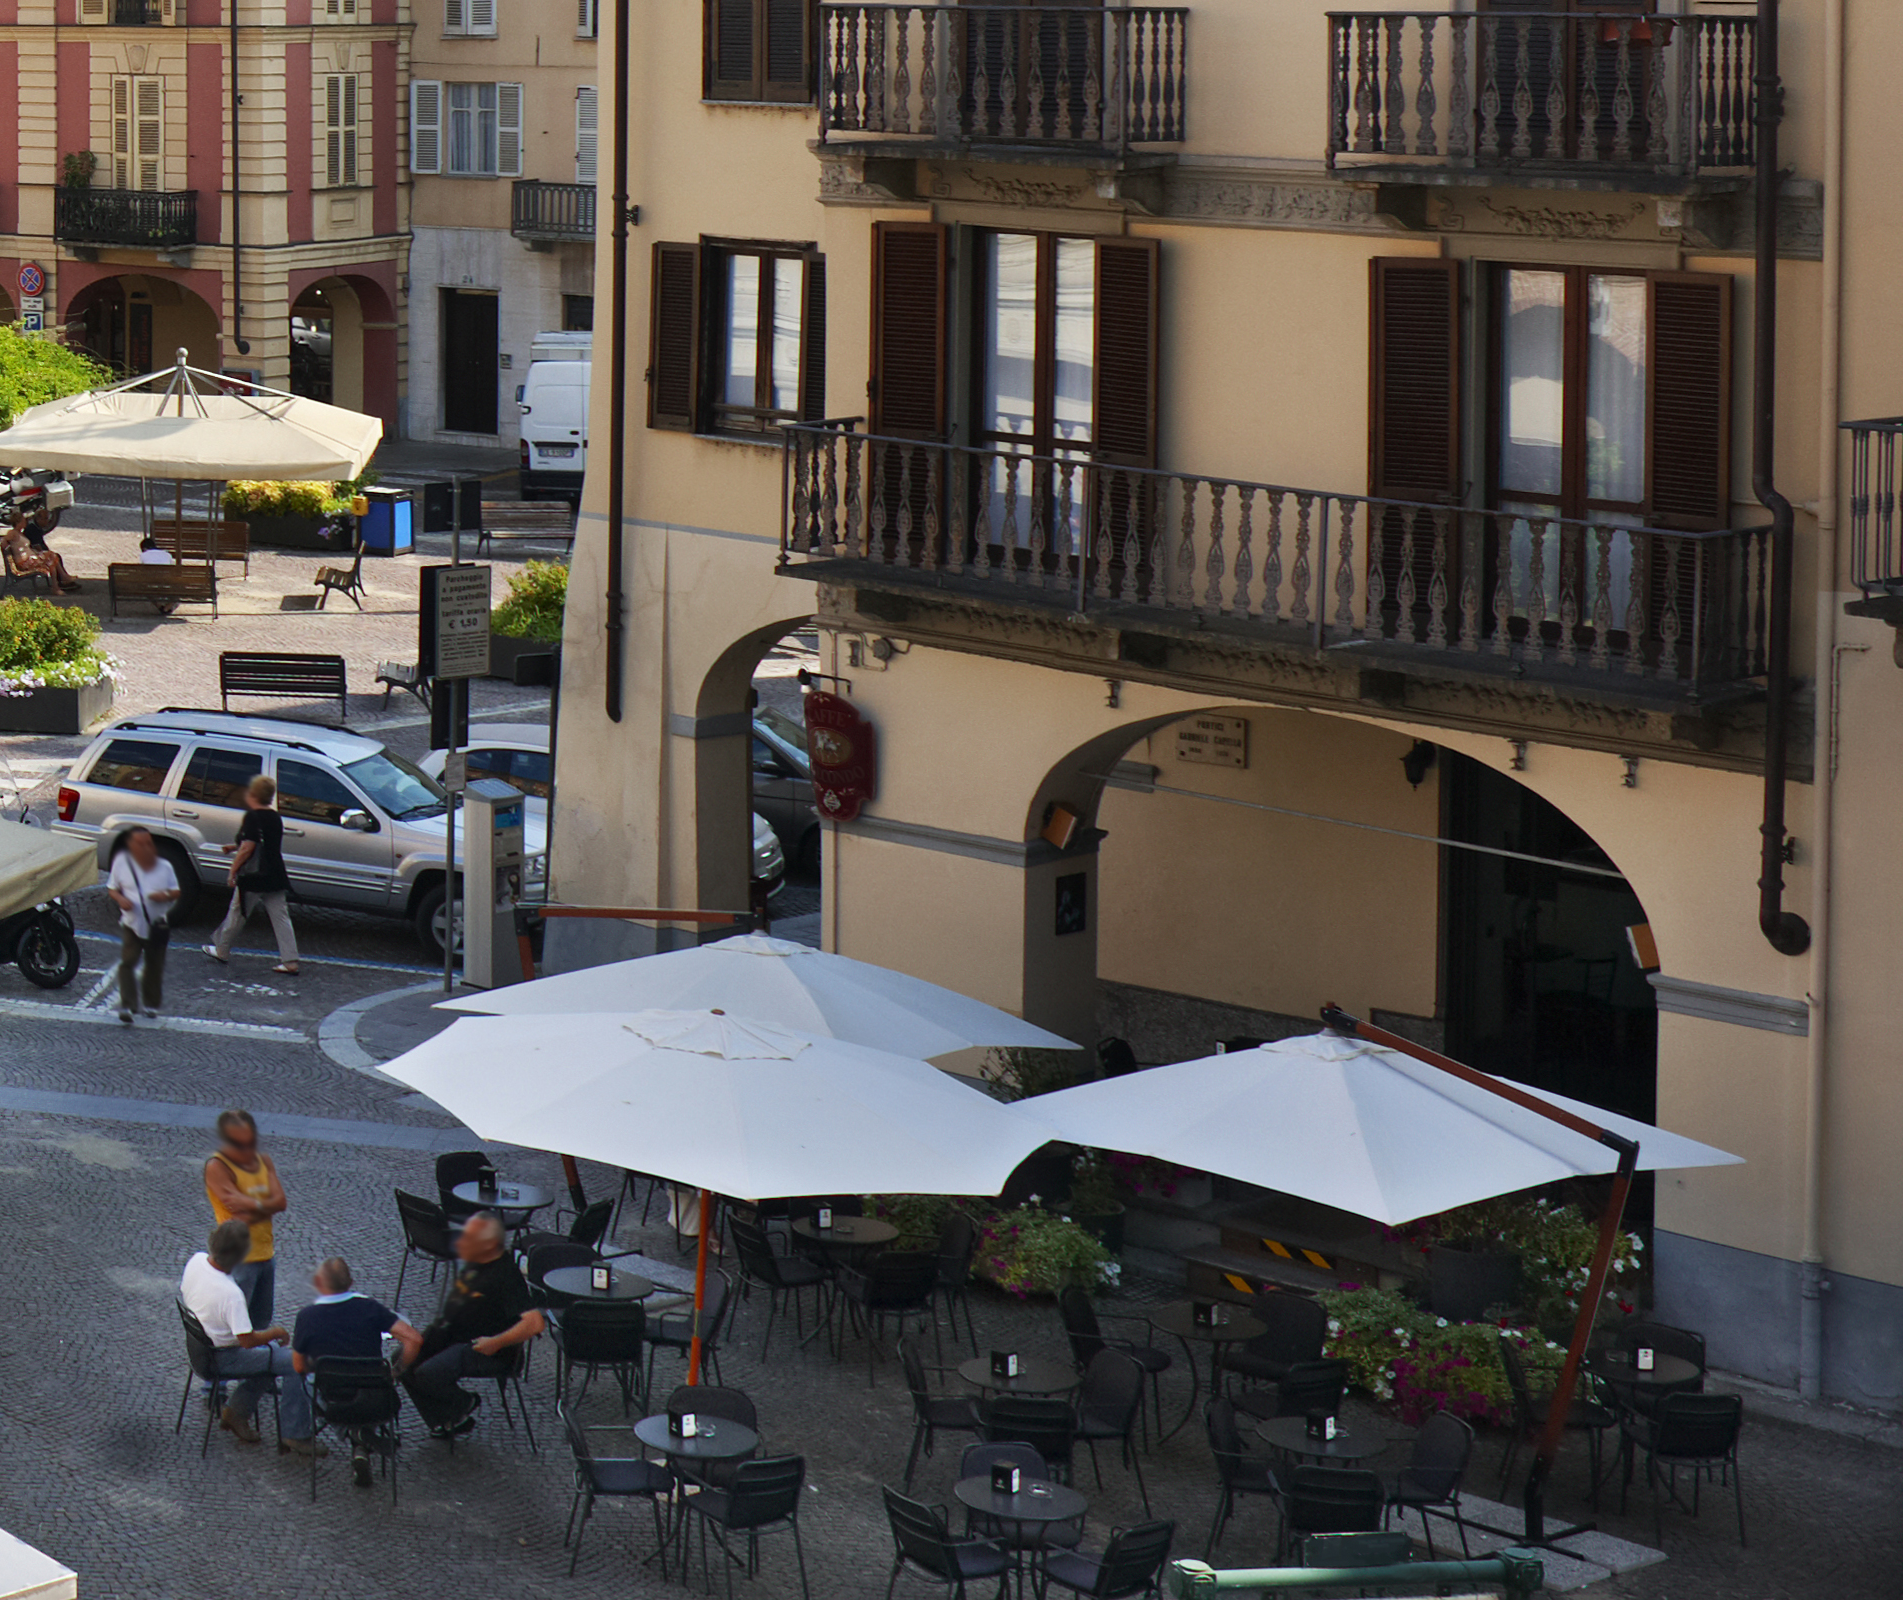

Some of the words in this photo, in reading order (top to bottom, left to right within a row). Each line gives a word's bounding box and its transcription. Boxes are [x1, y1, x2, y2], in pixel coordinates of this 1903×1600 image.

[27, 316, 38, 329] P
[446, 573, 484, 583] Parcheggio
[449, 582, 487, 593] pagamento
